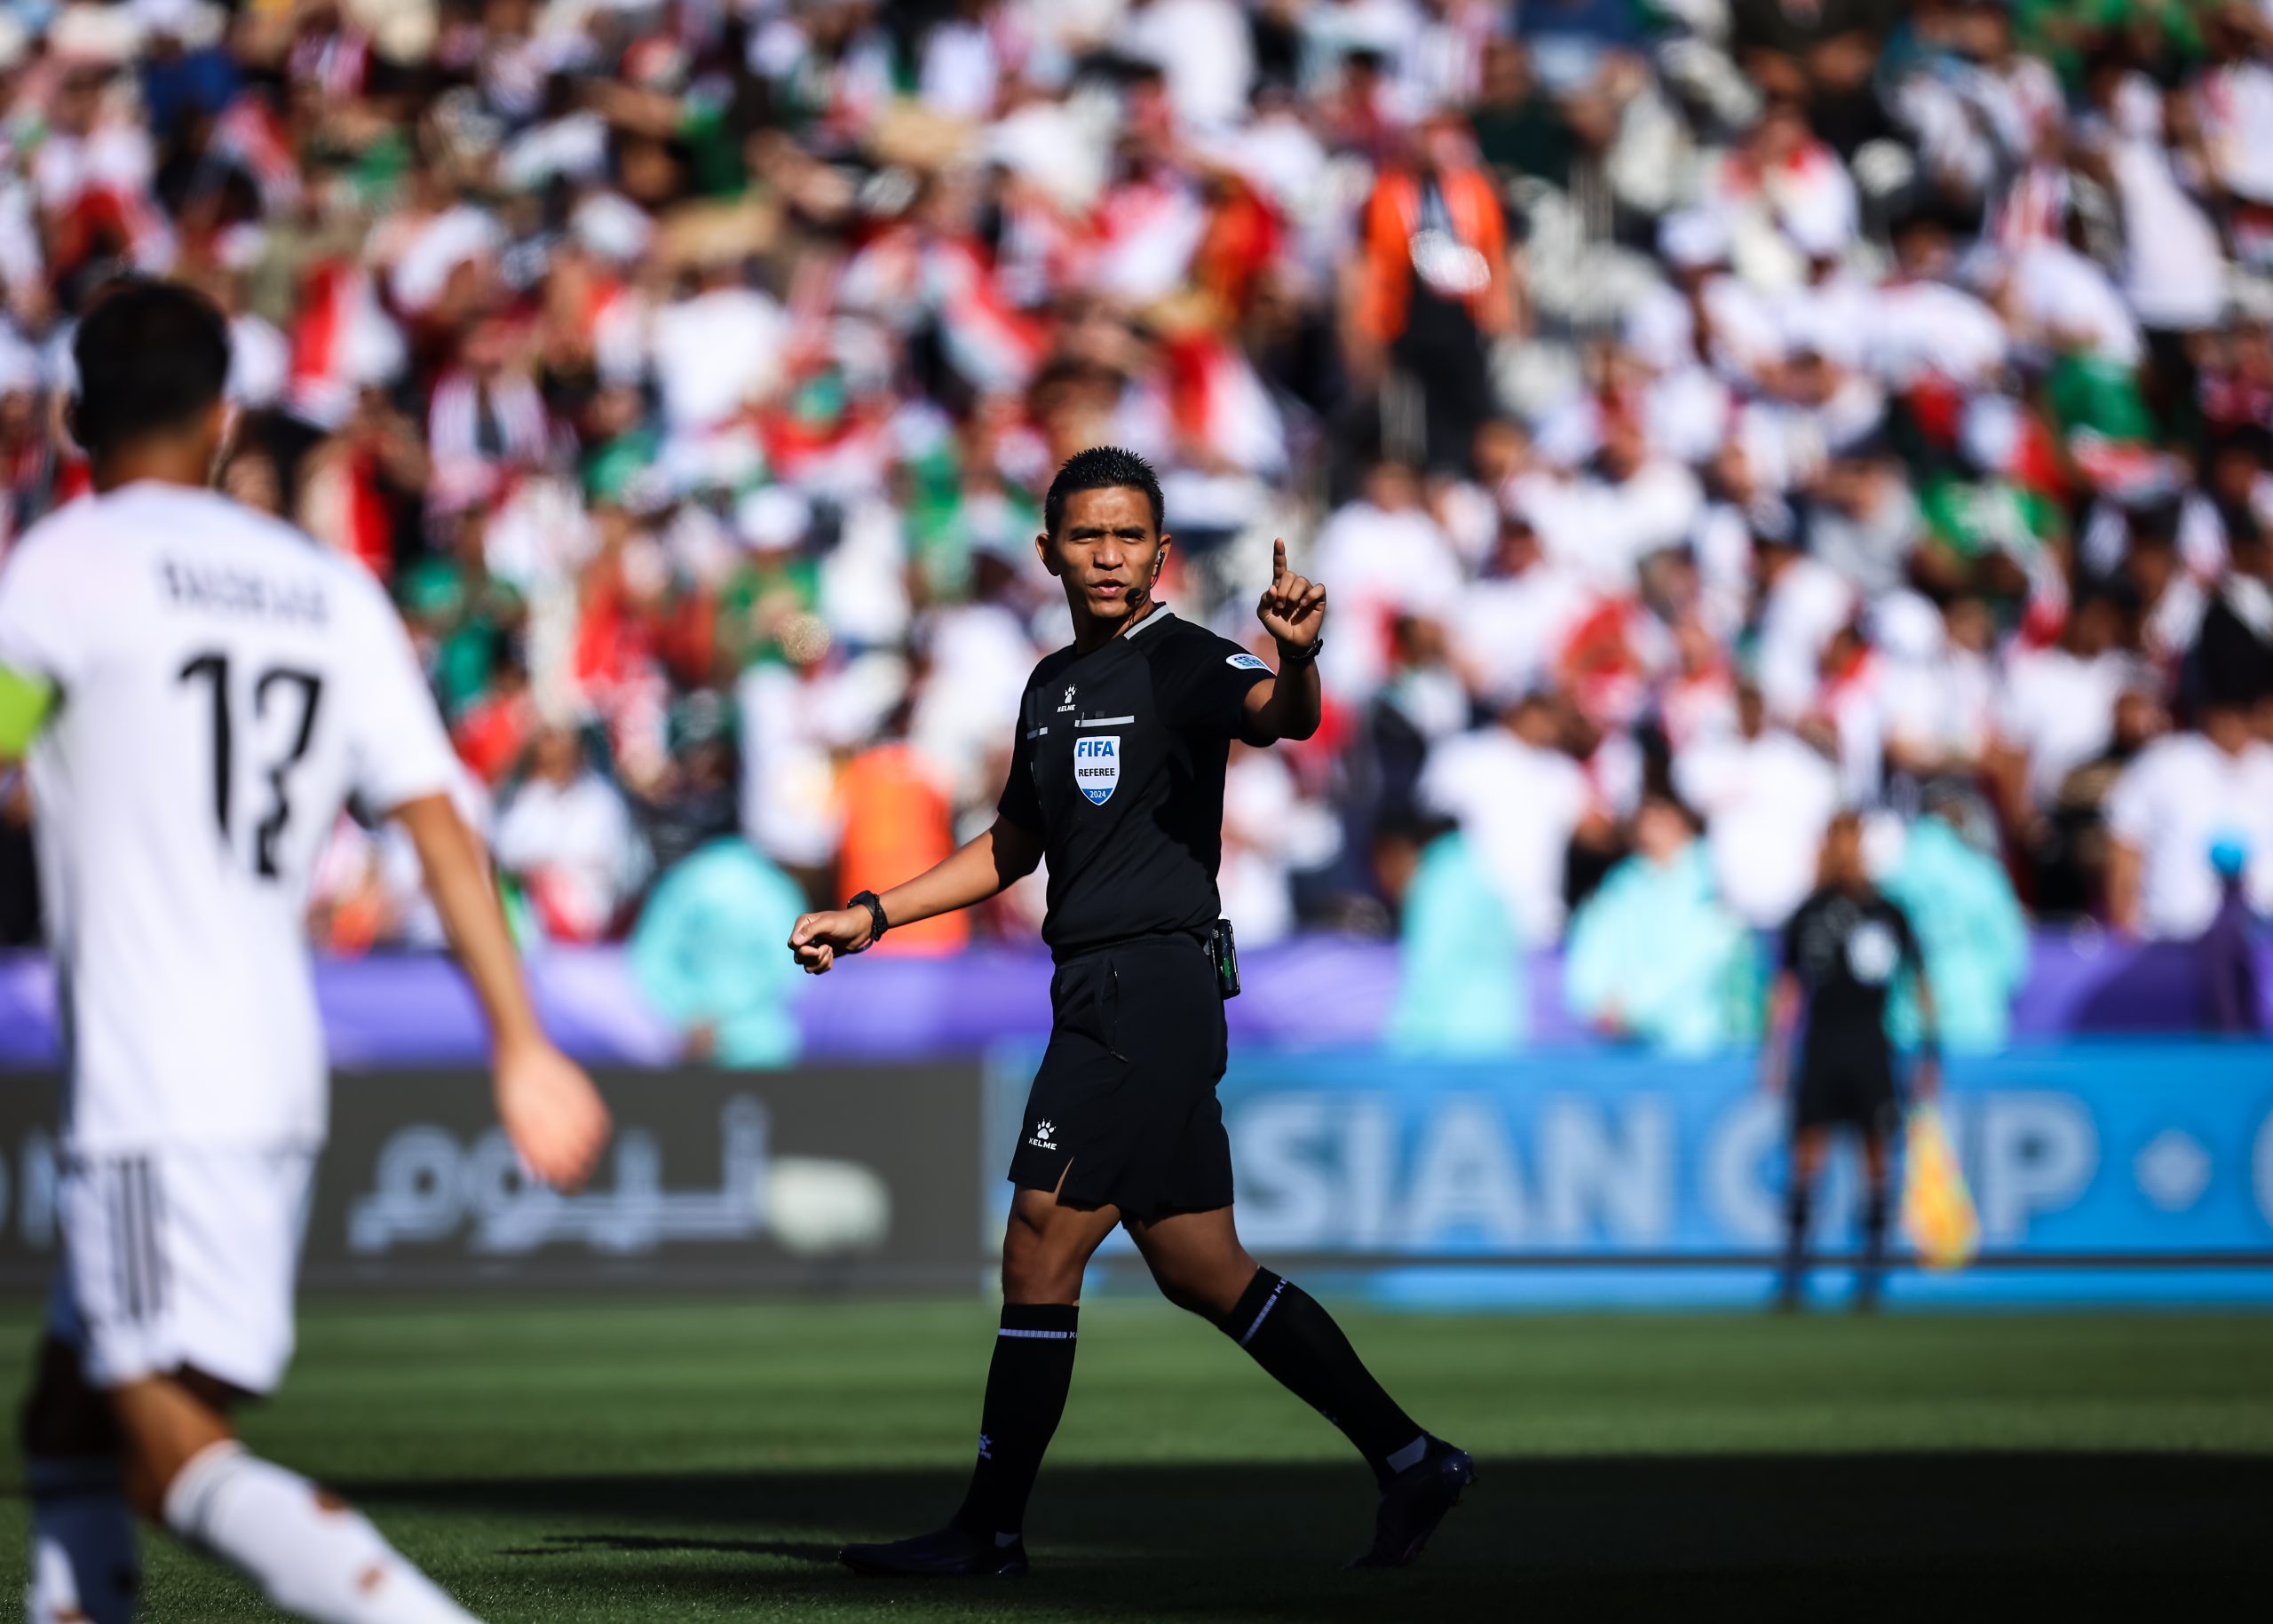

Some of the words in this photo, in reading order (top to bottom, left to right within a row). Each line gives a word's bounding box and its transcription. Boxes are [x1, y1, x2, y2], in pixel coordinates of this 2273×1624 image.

[1057, 704, 1076, 713] KELME
[1078, 741, 1115, 757] FIFA
[1078, 767, 1116, 777] REFEREE
[1089, 790, 1107, 799] 2024
[1028, 1137, 1057, 1151] KELME
[1232, 1089, 1676, 1250] SIAN
